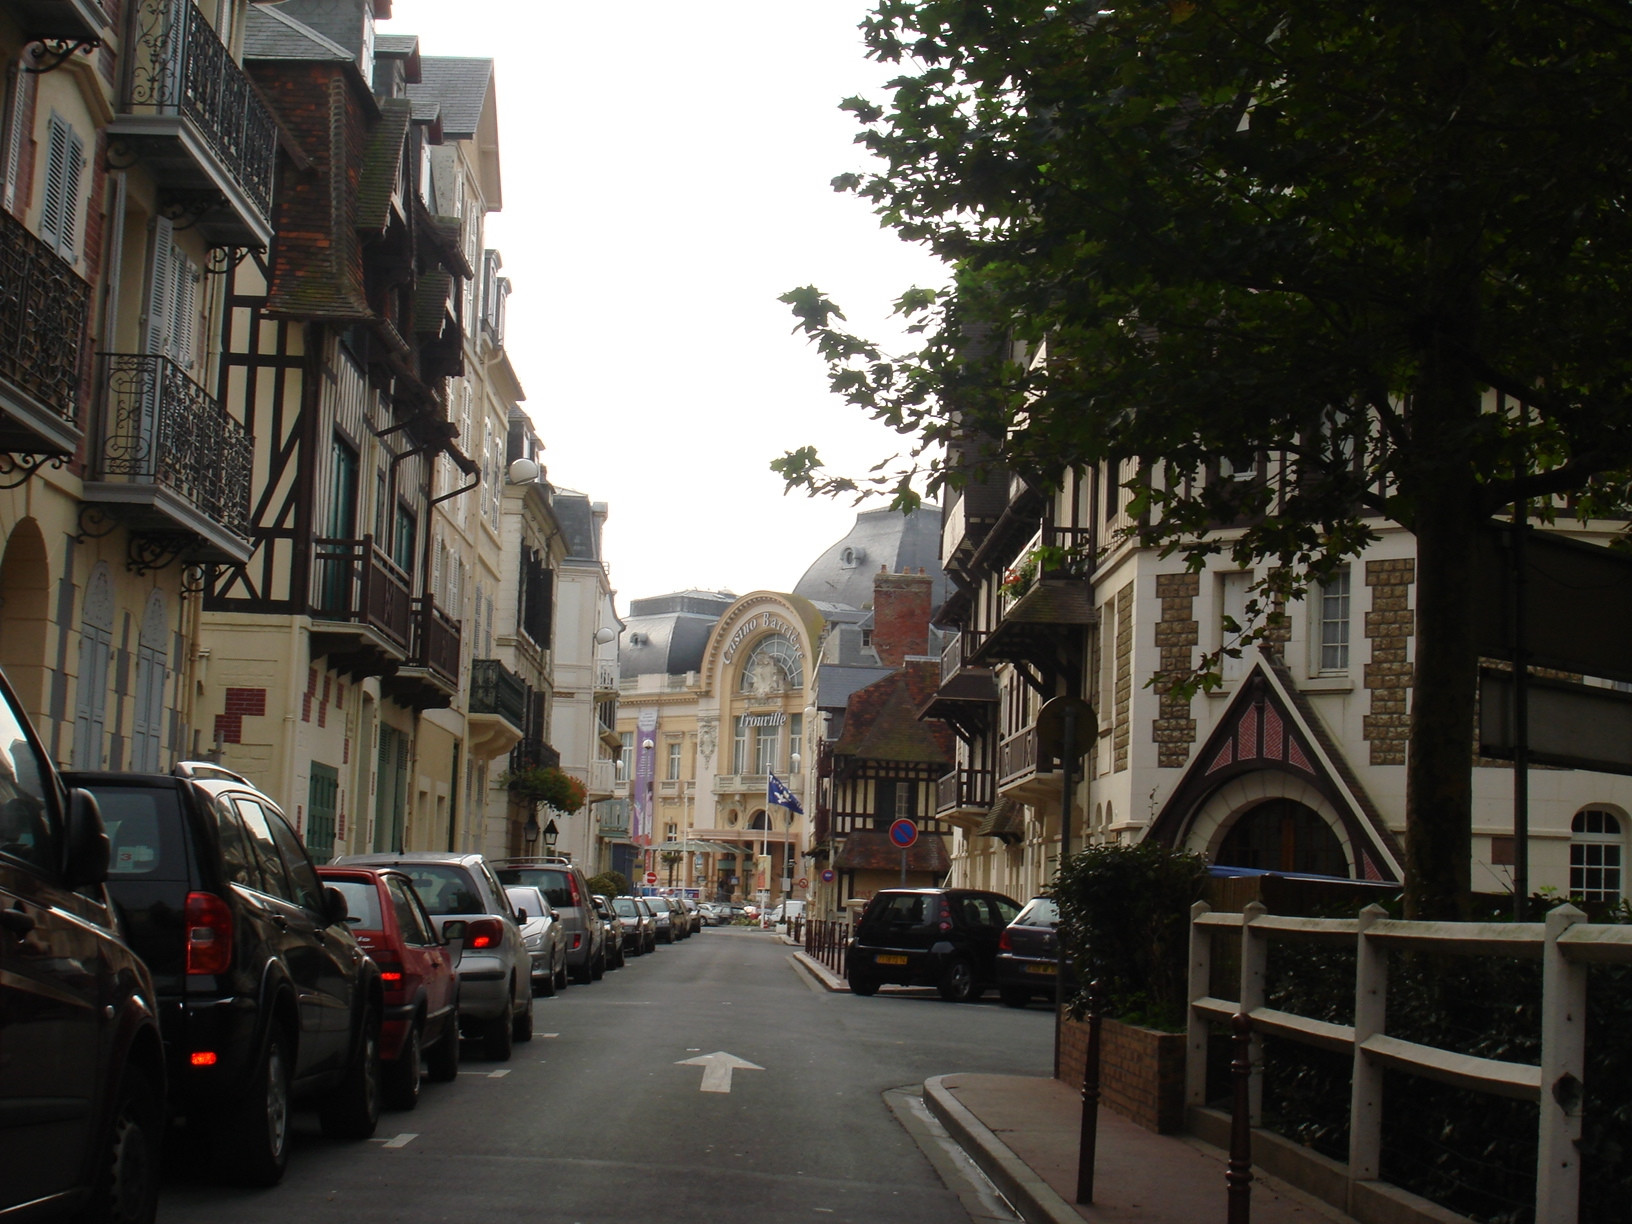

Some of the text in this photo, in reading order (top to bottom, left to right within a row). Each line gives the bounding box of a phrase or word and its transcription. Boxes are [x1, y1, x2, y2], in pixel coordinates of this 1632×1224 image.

[723, 613, 804, 664] Casino Barrière
[739, 712, 787, 728] Trouville
